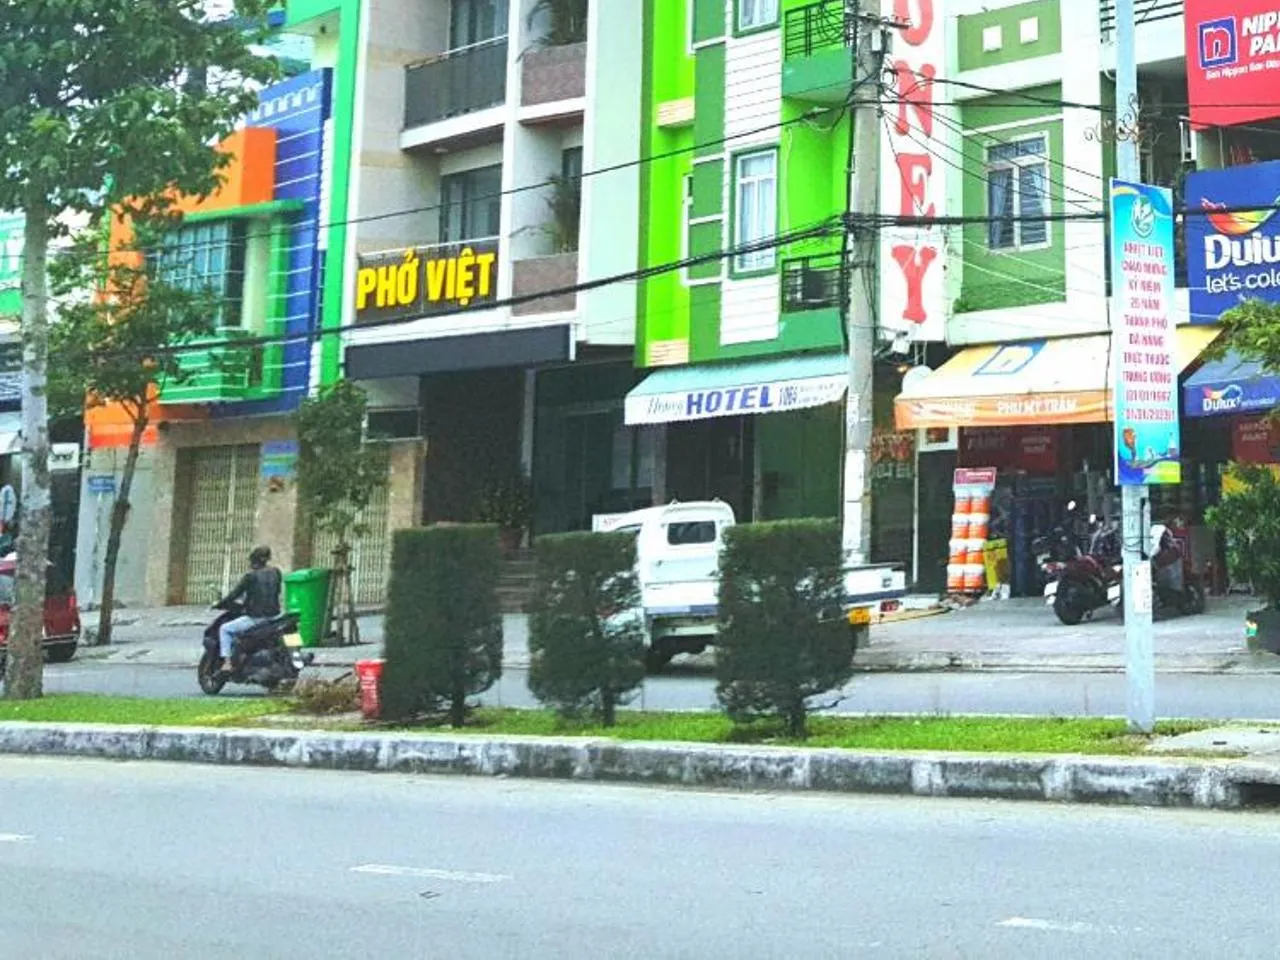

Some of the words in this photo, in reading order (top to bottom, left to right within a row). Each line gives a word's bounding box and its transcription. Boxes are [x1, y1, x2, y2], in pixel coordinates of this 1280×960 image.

[356, 247, 420, 310] PHỞ
[426, 246, 496, 306] VIỆT
[1205, 272, 1241, 294] let's
[687, 384, 774, 416] HOTEL
[1202, 398, 1237, 411] Dulux
